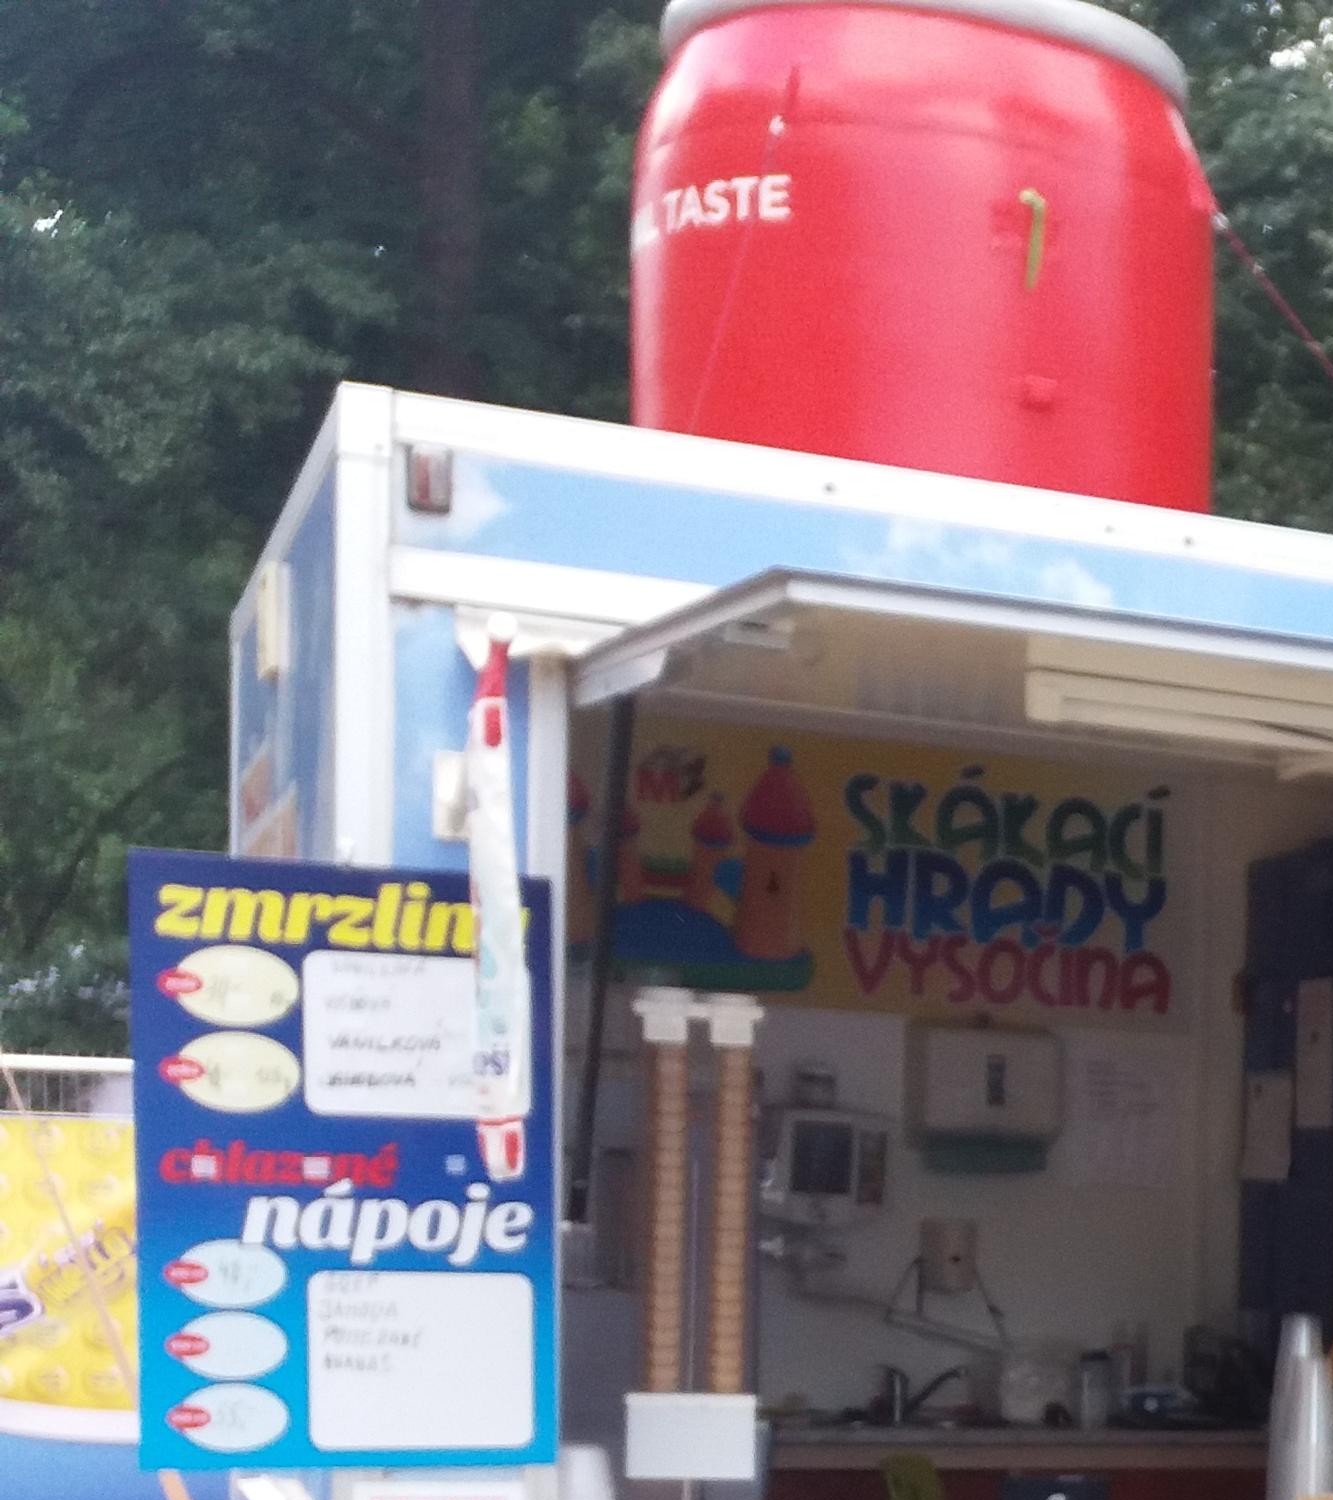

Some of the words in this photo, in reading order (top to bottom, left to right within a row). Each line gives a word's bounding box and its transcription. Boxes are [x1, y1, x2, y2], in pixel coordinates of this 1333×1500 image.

[662, 174, 792, 233] TASTE
[844, 764, 1171, 880] SKÁKACÍ
[154, 882, 530, 955] zmrzlin
[846, 849, 1167, 953] HRADY
[844, 924, 1172, 1015] VYSOČINA
[242, 1178, 534, 1266] nápoje
